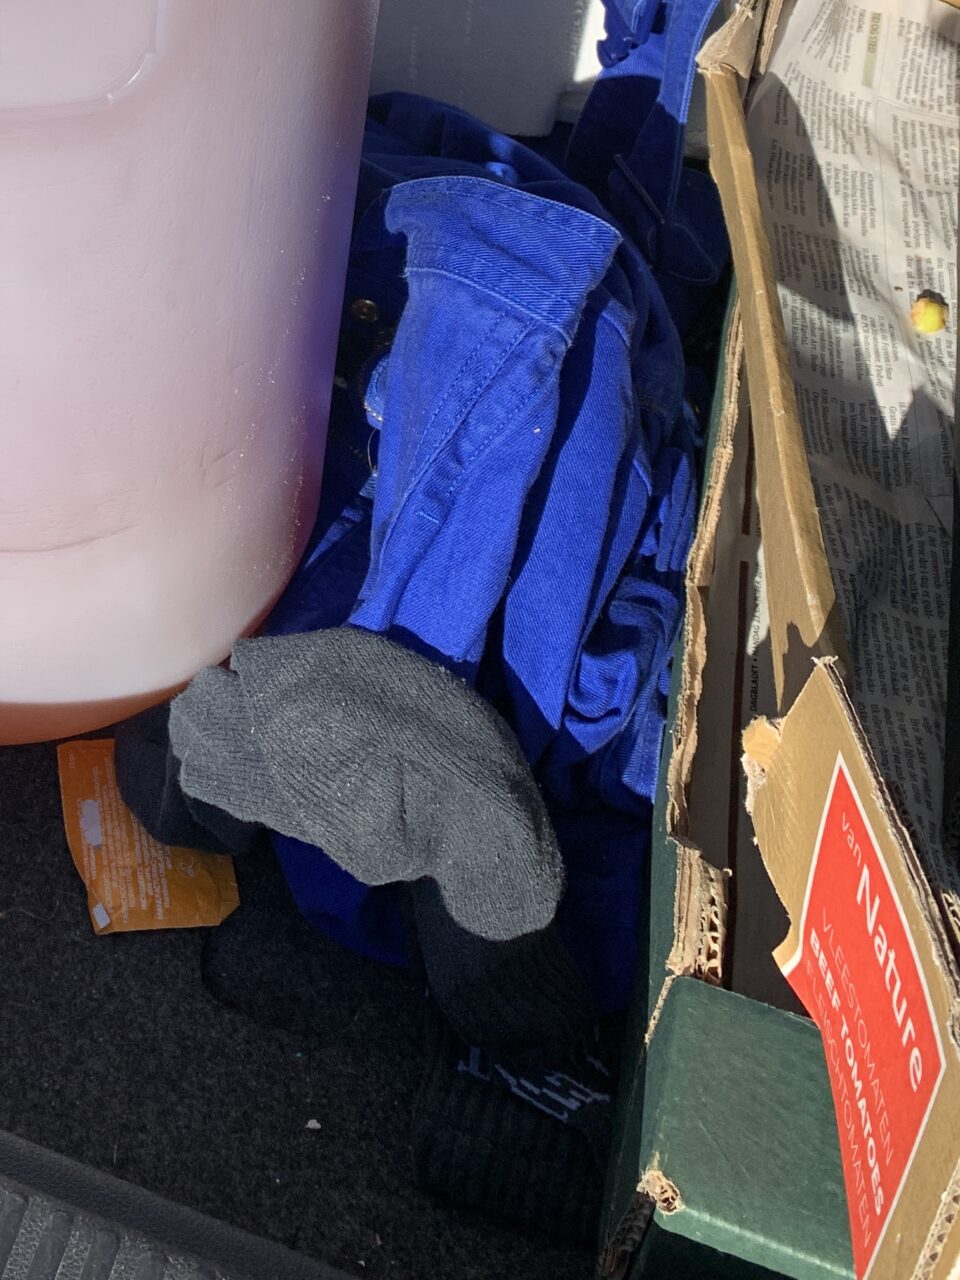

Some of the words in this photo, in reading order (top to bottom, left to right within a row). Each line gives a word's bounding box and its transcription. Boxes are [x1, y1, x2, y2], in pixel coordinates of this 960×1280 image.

[868, 36, 879, 54] STED
[870, 24, 880, 34] OG
[841, 811, 862, 866] van
[810, 927, 840, 1012] BEEF
[840, 1014, 885, 1216] TOMATOES
[822, 906, 894, 1166] VLEESTOMATEN
[855, 863, 923, 1093] Nature
[806, 959, 872, 1248] FLEISCHTOMATEN
